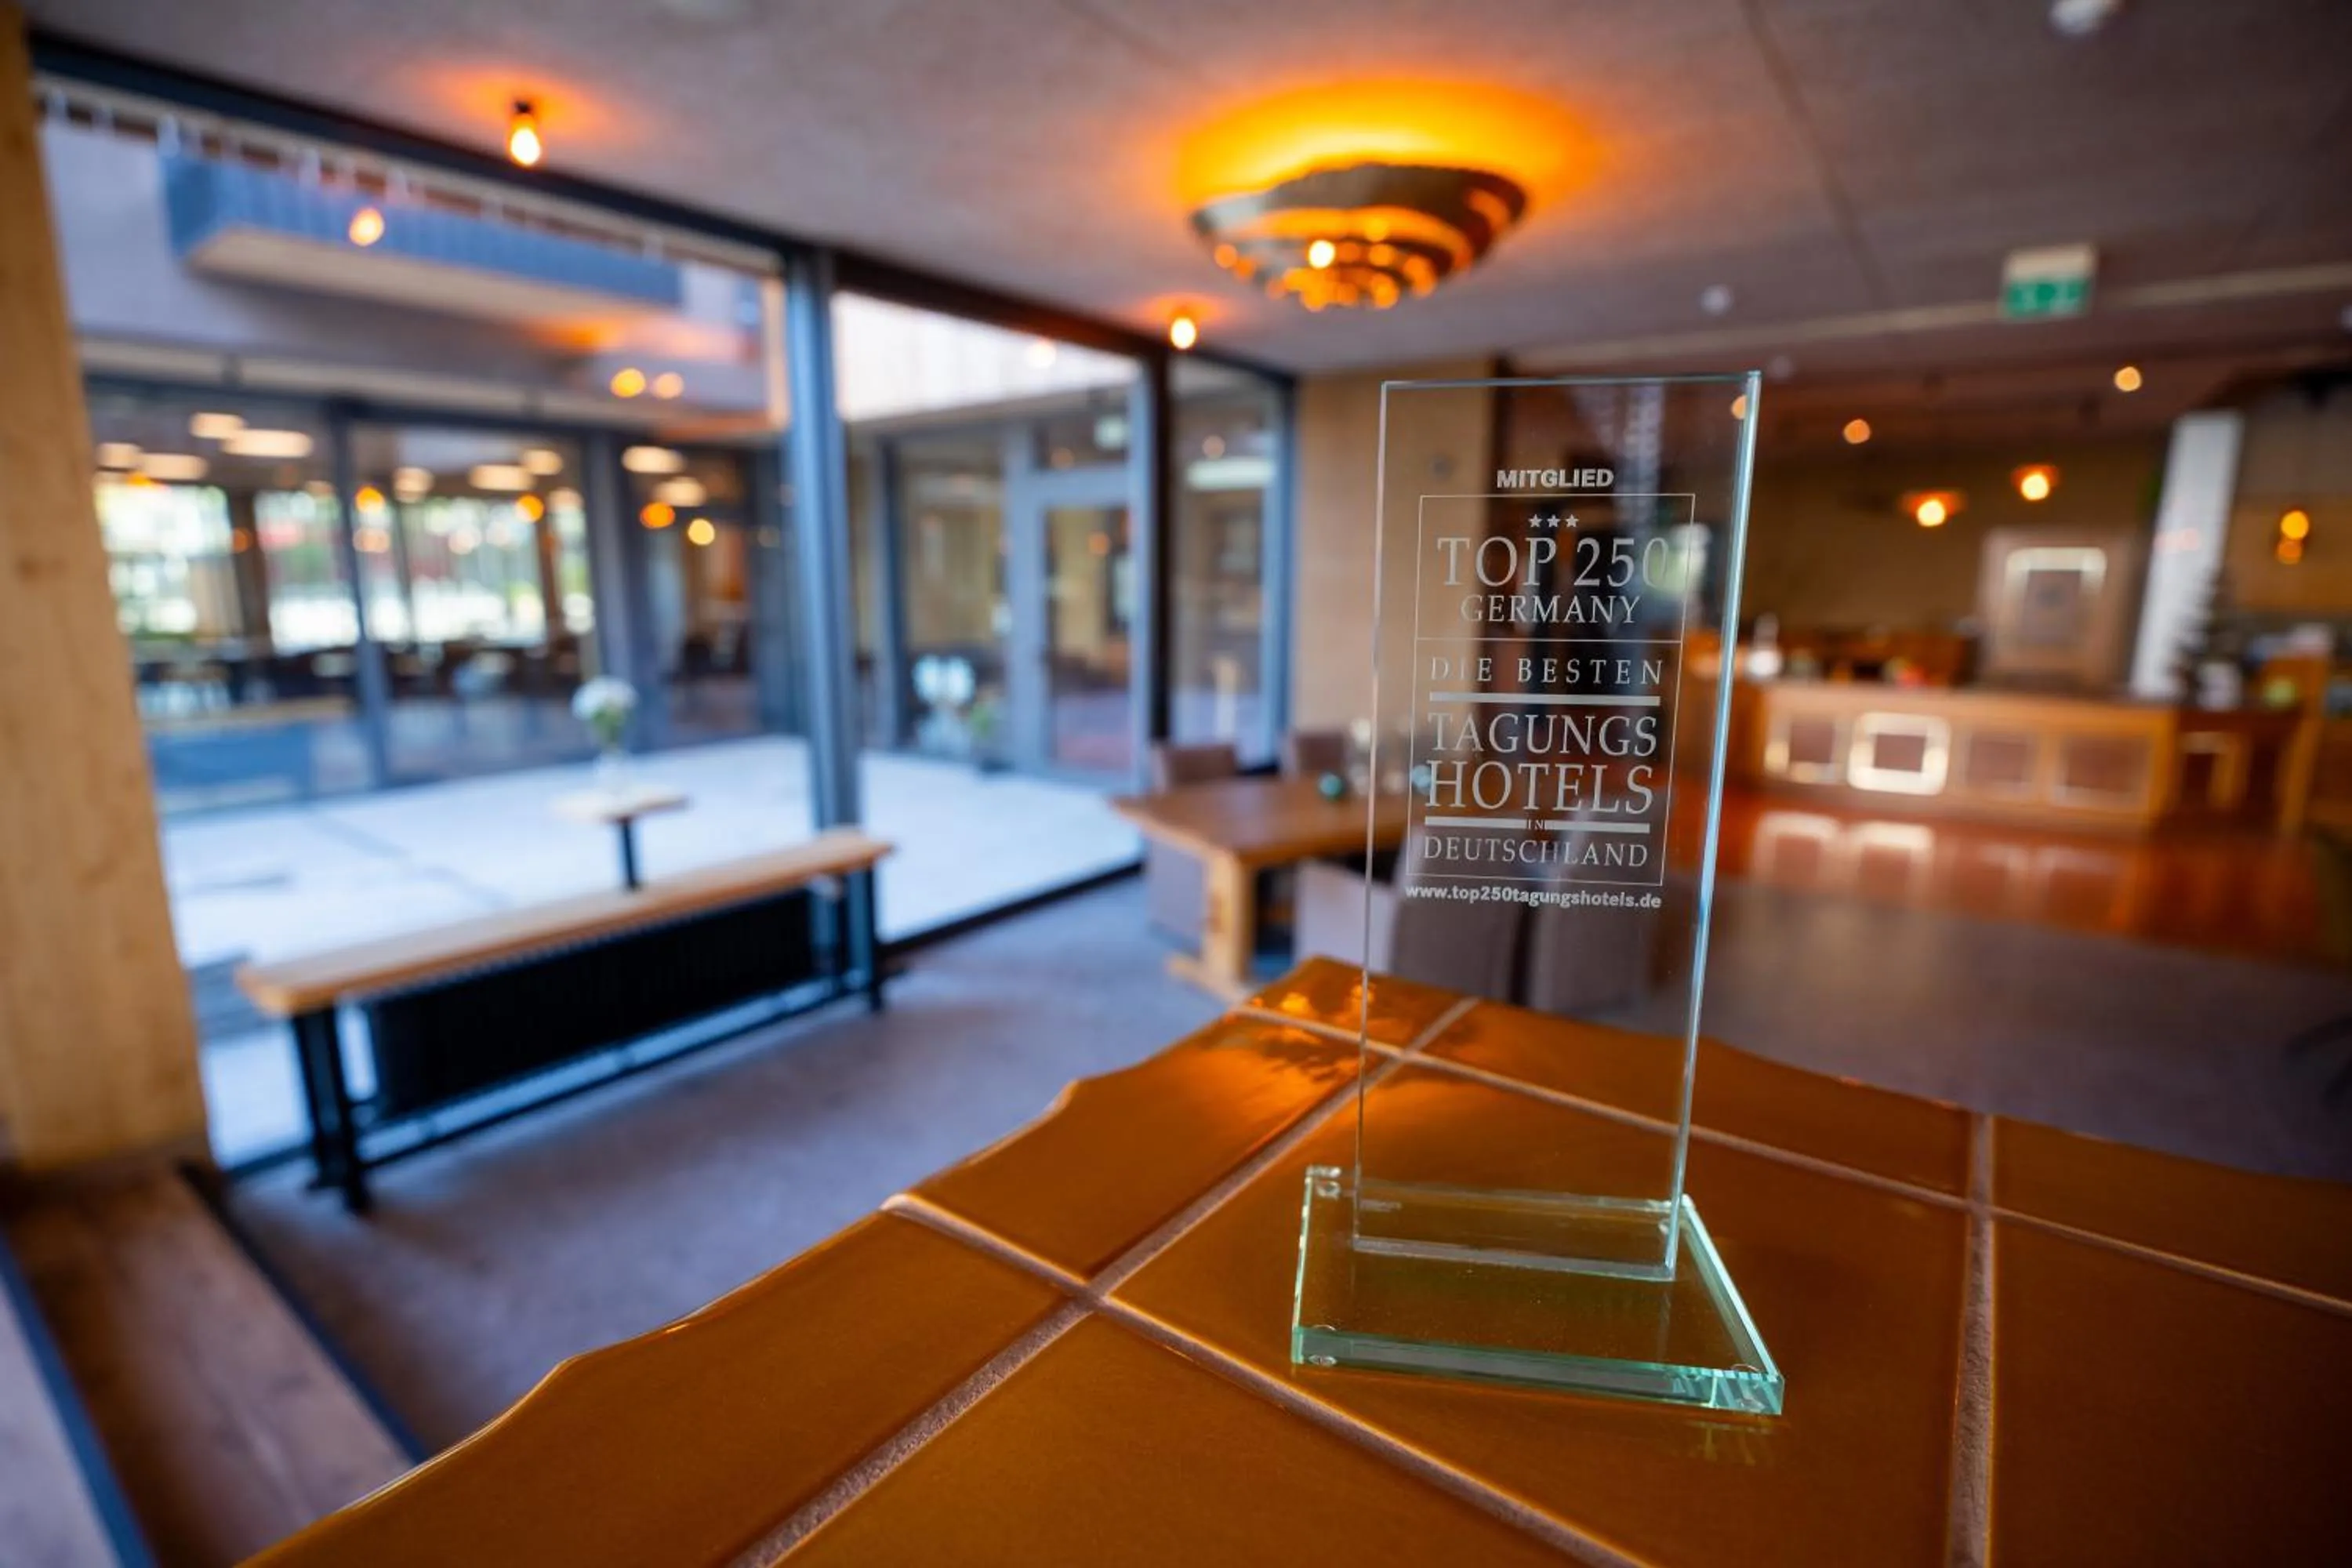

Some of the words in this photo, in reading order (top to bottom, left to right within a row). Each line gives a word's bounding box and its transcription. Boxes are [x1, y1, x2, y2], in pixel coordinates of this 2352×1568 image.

[1497, 469, 1613, 488] MITGLIED
[1437, 536, 1557, 587] TOP
[1574, 538, 1668, 589] 250
[1461, 594, 1640, 623] GERMANY
[1431, 657, 1492, 681] DIE
[1518, 658, 1663, 684] BESTEN
[1428, 712, 1657, 757] TAGUNGS
[1425, 760, 1653, 815] HOTELS
[1527, 819, 1544, 830] IN
[1424, 836, 1647, 867] DEUTSCHLAND
[1405, 884, 1662, 909] www.top250tagungshotels.de
